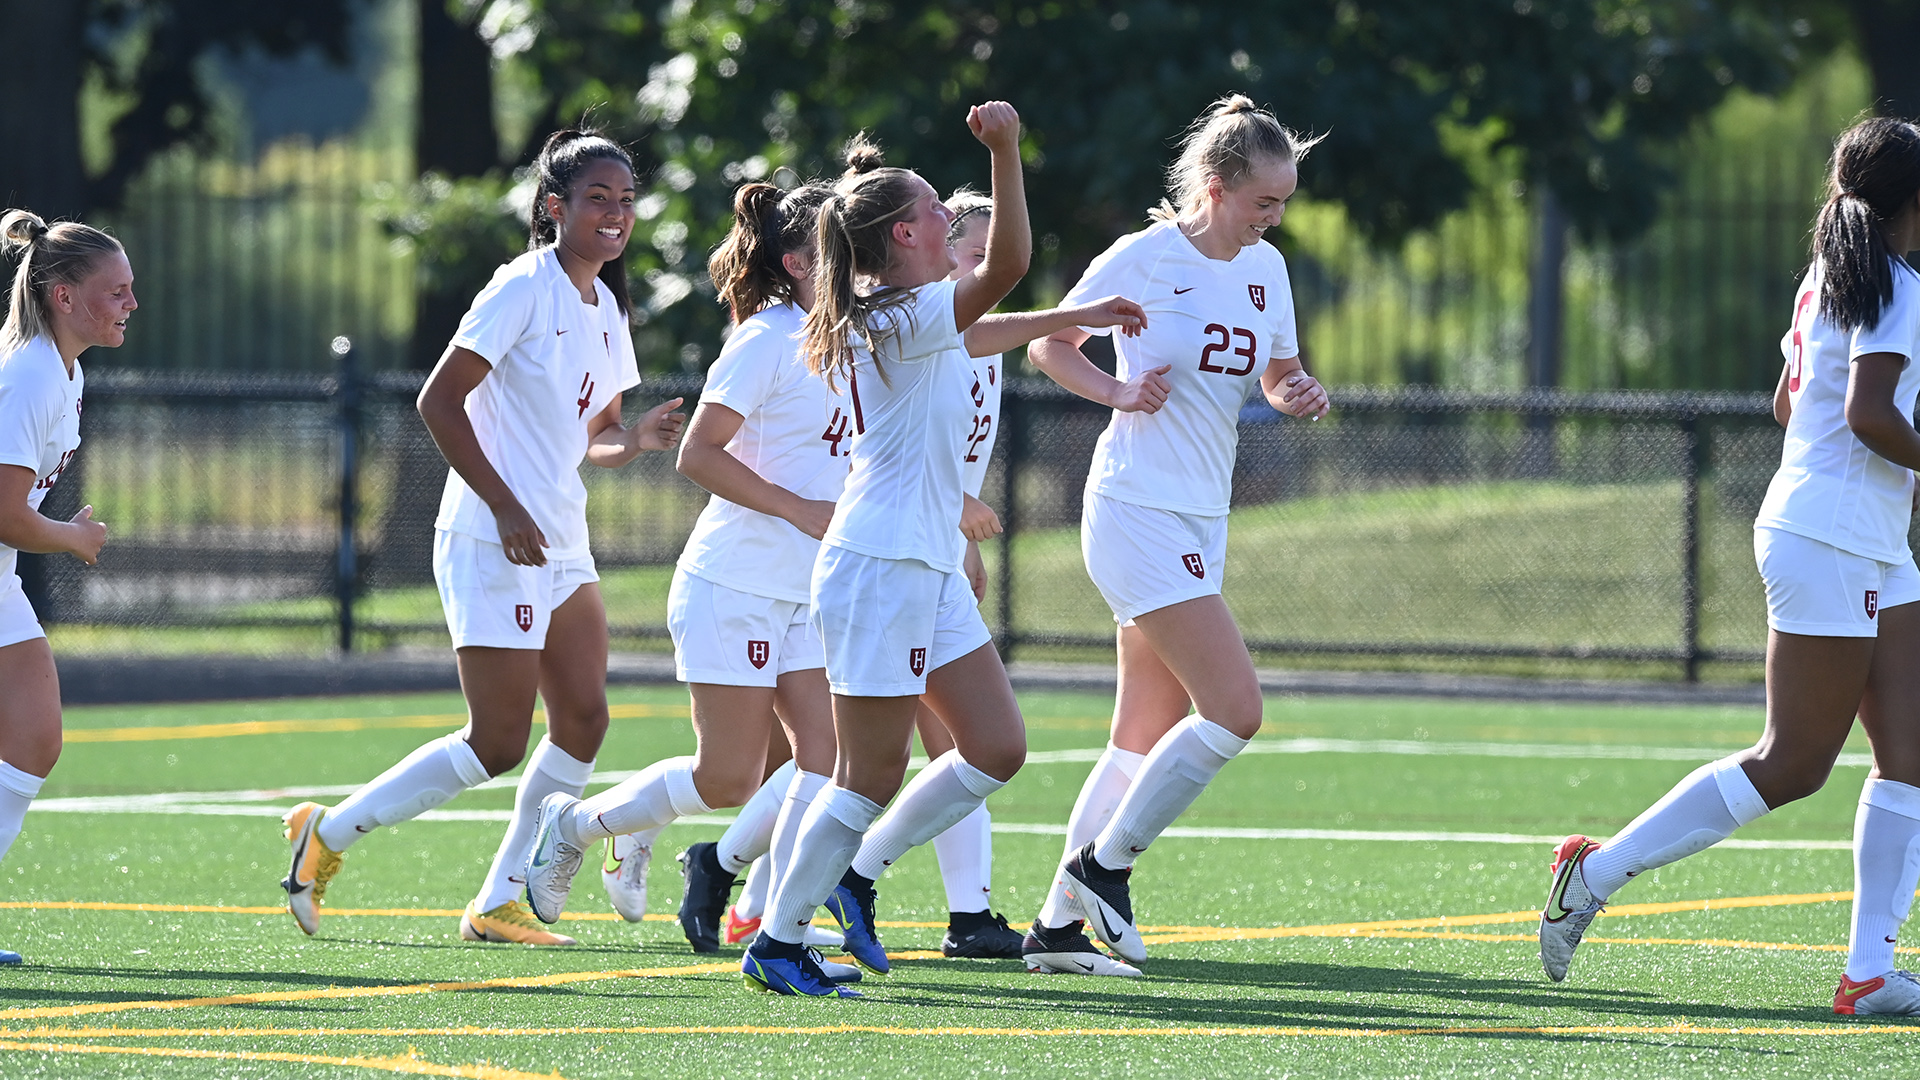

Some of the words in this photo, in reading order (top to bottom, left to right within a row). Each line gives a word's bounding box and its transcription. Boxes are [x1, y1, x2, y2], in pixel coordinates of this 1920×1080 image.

[1198, 323, 1257, 376] 23
[577, 371, 595, 420] 4
[822, 407, 853, 457] 4
